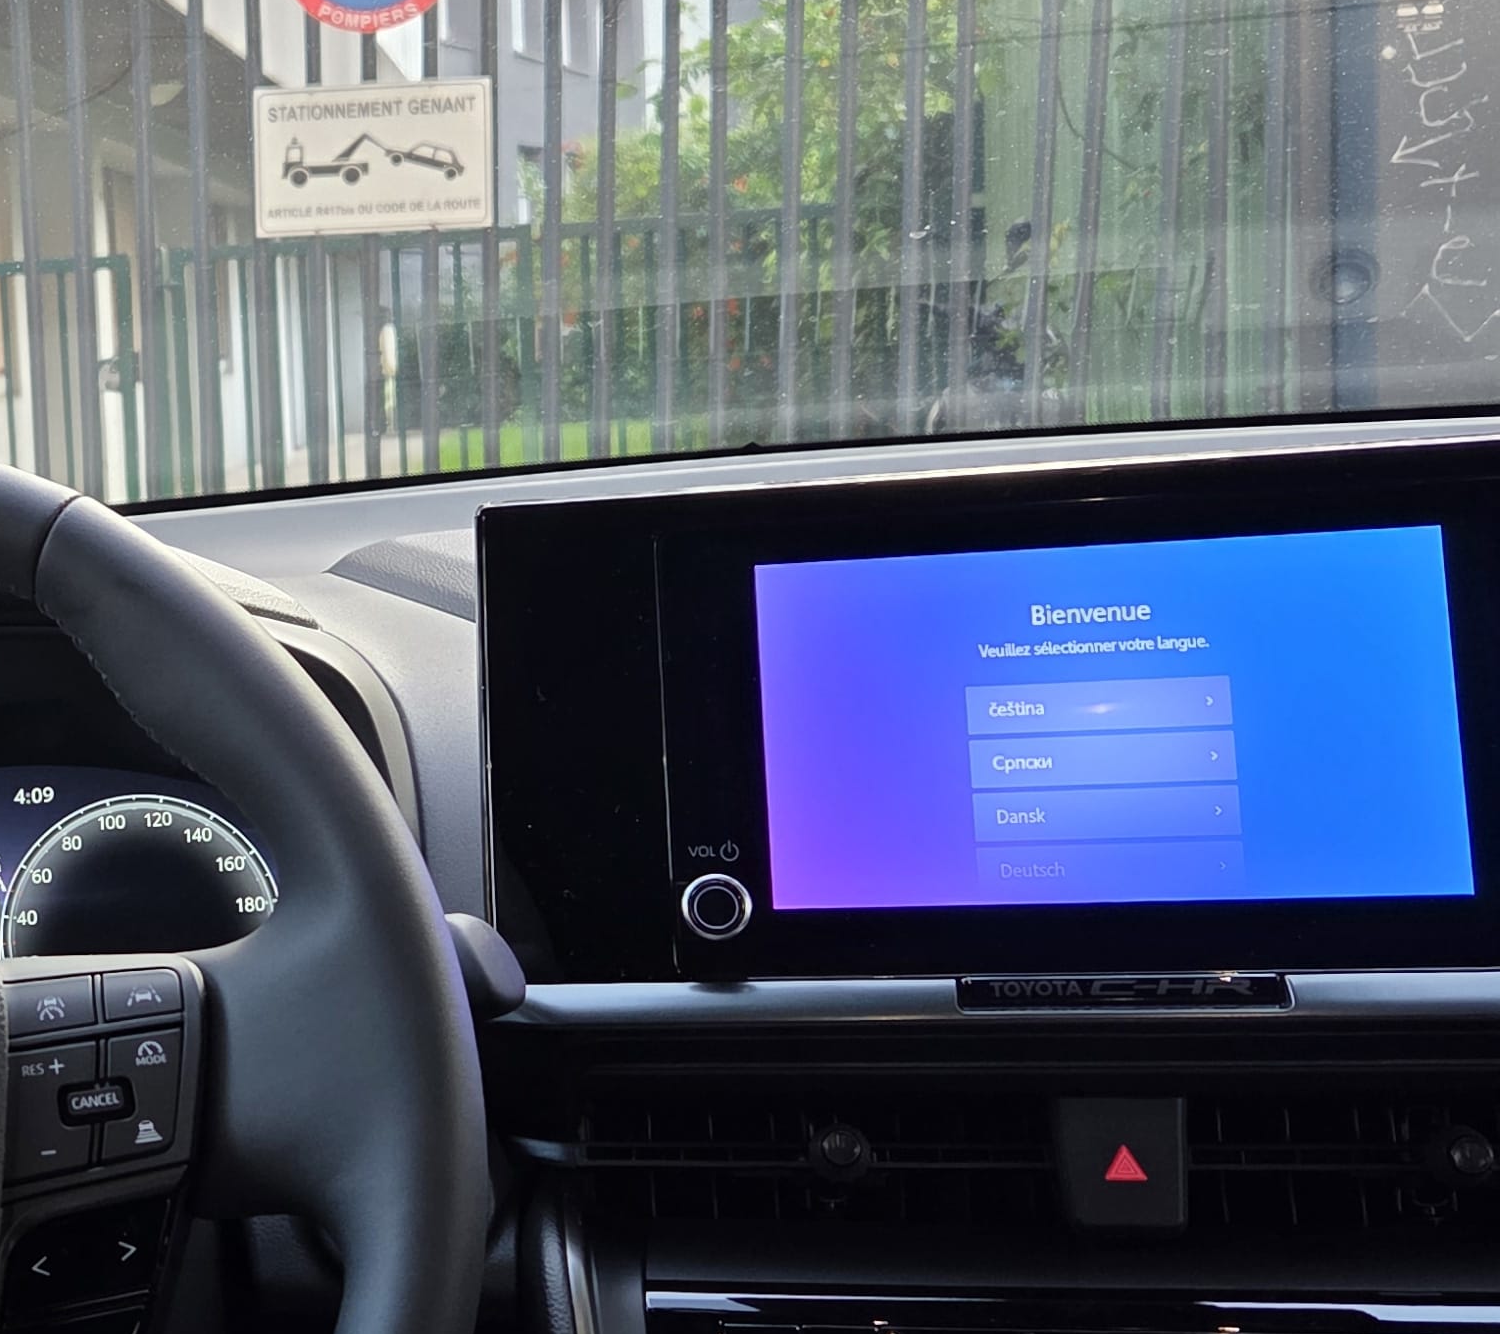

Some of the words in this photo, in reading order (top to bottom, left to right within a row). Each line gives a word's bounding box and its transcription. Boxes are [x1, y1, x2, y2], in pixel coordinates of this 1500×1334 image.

[317, 1, 418, 28] POMPIERS
[267, 100, 402, 123] STATIONNEMENT
[407, 96, 476, 115] GENANT
[268, 206, 312, 218] ARTICLE
[375, 202, 406, 213] CODE
[409, 200, 424, 212] DE
[426, 199, 441, 211] LA
[443, 197, 481, 210] ROUTE
[1030, 603, 1151, 626] Bienvenue
[977, 642, 1031, 658] Veuillez
[1034, 640, 1117, 656] sélectionner
[1118, 637, 1155, 651] votre
[1156, 635, 1210, 652] langue.
[992, 755, 1053, 775] Српски
[13, 786, 55, 805] 4:09
[98, 814, 126, 831] 100
[144, 811, 172, 828] 120
[996, 807, 1046, 825] Dansk
[61, 835, 82, 852] 80
[184, 827, 212, 844] 140
[687, 845, 717, 858] VOL
[216, 855, 245, 872] 160
[1000, 862, 1066, 879] Deutsch
[31, 868, 52, 885] 60
[236, 896, 266, 913] 180
[16, 909, 38, 926] 40
[989, 981, 1084, 997] TOYOTA
[1089, 979, 1253, 996] C-HR
[135, 1055, 168, 1067] MODE
[21, 1063, 45, 1078] RES
[71, 1091, 121, 1111] CANCEL
